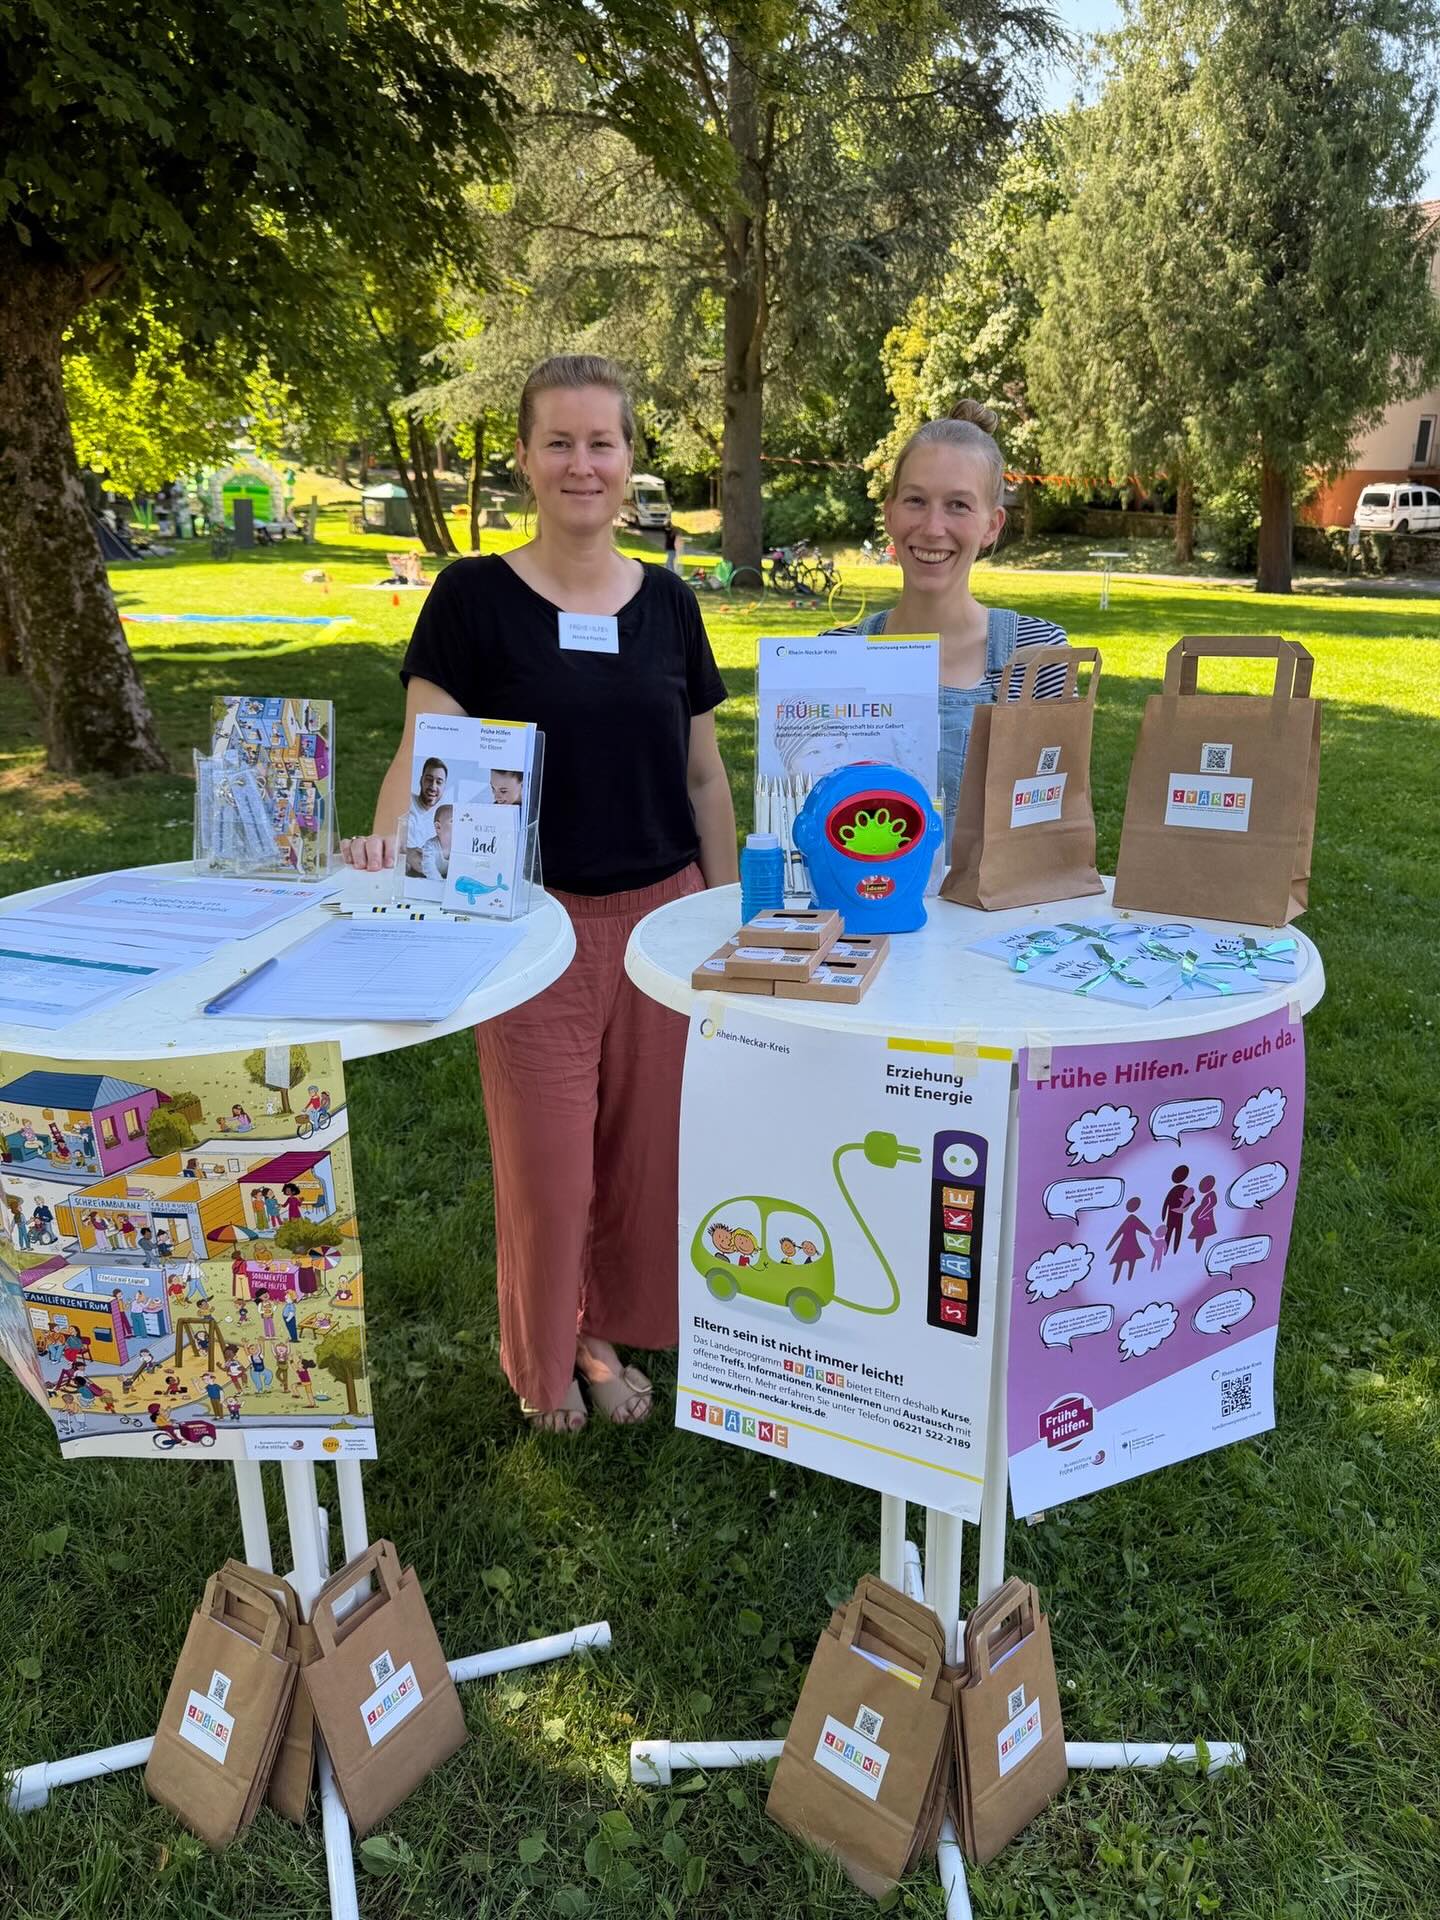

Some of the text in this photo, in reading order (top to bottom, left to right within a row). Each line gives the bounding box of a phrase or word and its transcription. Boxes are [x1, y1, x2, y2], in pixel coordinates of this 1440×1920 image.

[776, 701, 893, 719] FRÜHE HILFEN
[480, 728, 511, 737] Frühe Hilfen
[471, 836, 498, 855] Bad
[716, 1030, 791, 1054] Rhein-Neckar-Kreis
[1115, 1060, 1190, 1085] Hilfen.
[1196, 1050, 1228, 1073] Für
[1232, 1039, 1272, 1064] euch
[1275, 1028, 1297, 1050] da.
[886, 1064, 964, 1088] Erziehung
[885, 1083, 973, 1105] mit Energie
[941, 1189, 973, 1323] STÄRKE
[24, 1292, 109, 1311] FAMILIENZENTRUM
[694, 1316, 904, 1386] Eltern sein ist nicht immer leicht!
[694, 1334, 708, 1346] Das
[710, 1339, 782, 1368] Landesprogramm
[846, 1379, 872, 1395] bietet
[875, 1388, 900, 1403] Eltern
[902, 1397, 939, 1414] deshalb
[941, 1408, 972, 1426] Kurse,
[692, 1372, 828, 1419] und www.rhein-neckar-kreis.de.
[693, 1347, 971, 1438] offene Treffs, Informationen, Kennenlernen und Austausch mit
[692, 1360, 971, 1450] anderen Eltern. Mehr erfahren Sie unter Telefon 06221 522-2189
[691, 1401, 788, 1448] STÄRKE
[1046, 1408, 1078, 1428] Frühe
[1052, 1418, 1089, 1440] Hilfen.
